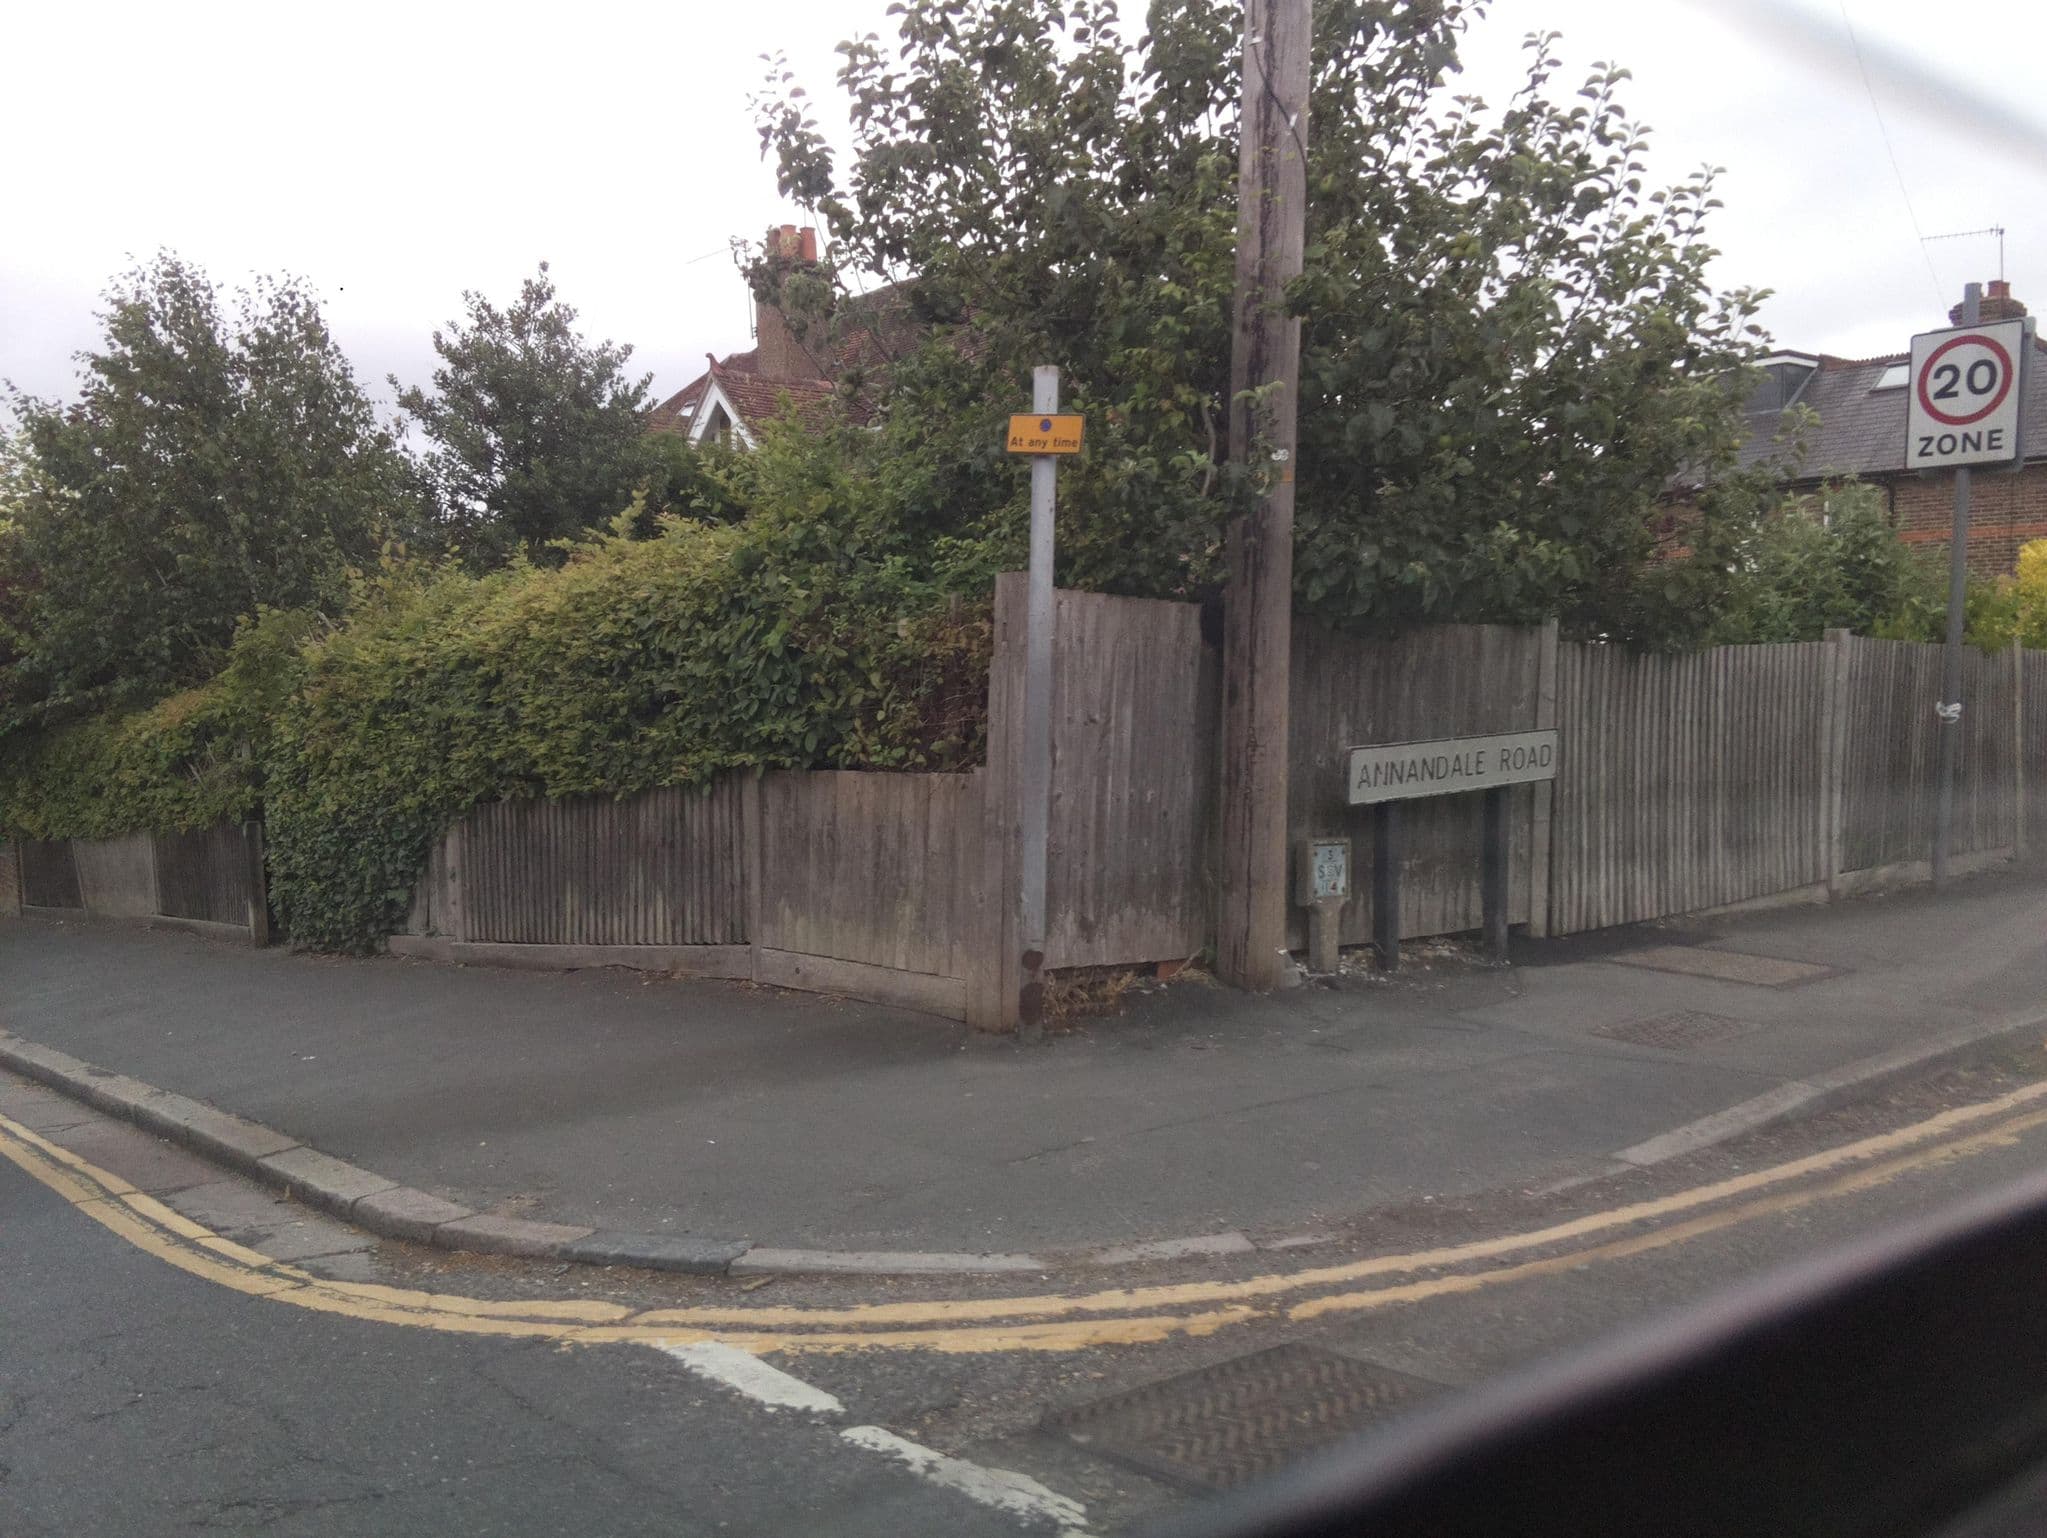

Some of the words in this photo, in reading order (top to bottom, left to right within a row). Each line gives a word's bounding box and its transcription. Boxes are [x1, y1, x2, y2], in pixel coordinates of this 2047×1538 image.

[1932, 358, 1998, 400] 20
[1010, 436, 1024, 447] At
[1028, 438, 1048, 449] any
[1053, 436, 1078, 448] time
[1917, 428, 2004, 457] ZONE
[1357, 750, 1486, 790] ANNANDALE
[1499, 744, 1552, 771] ROAD
